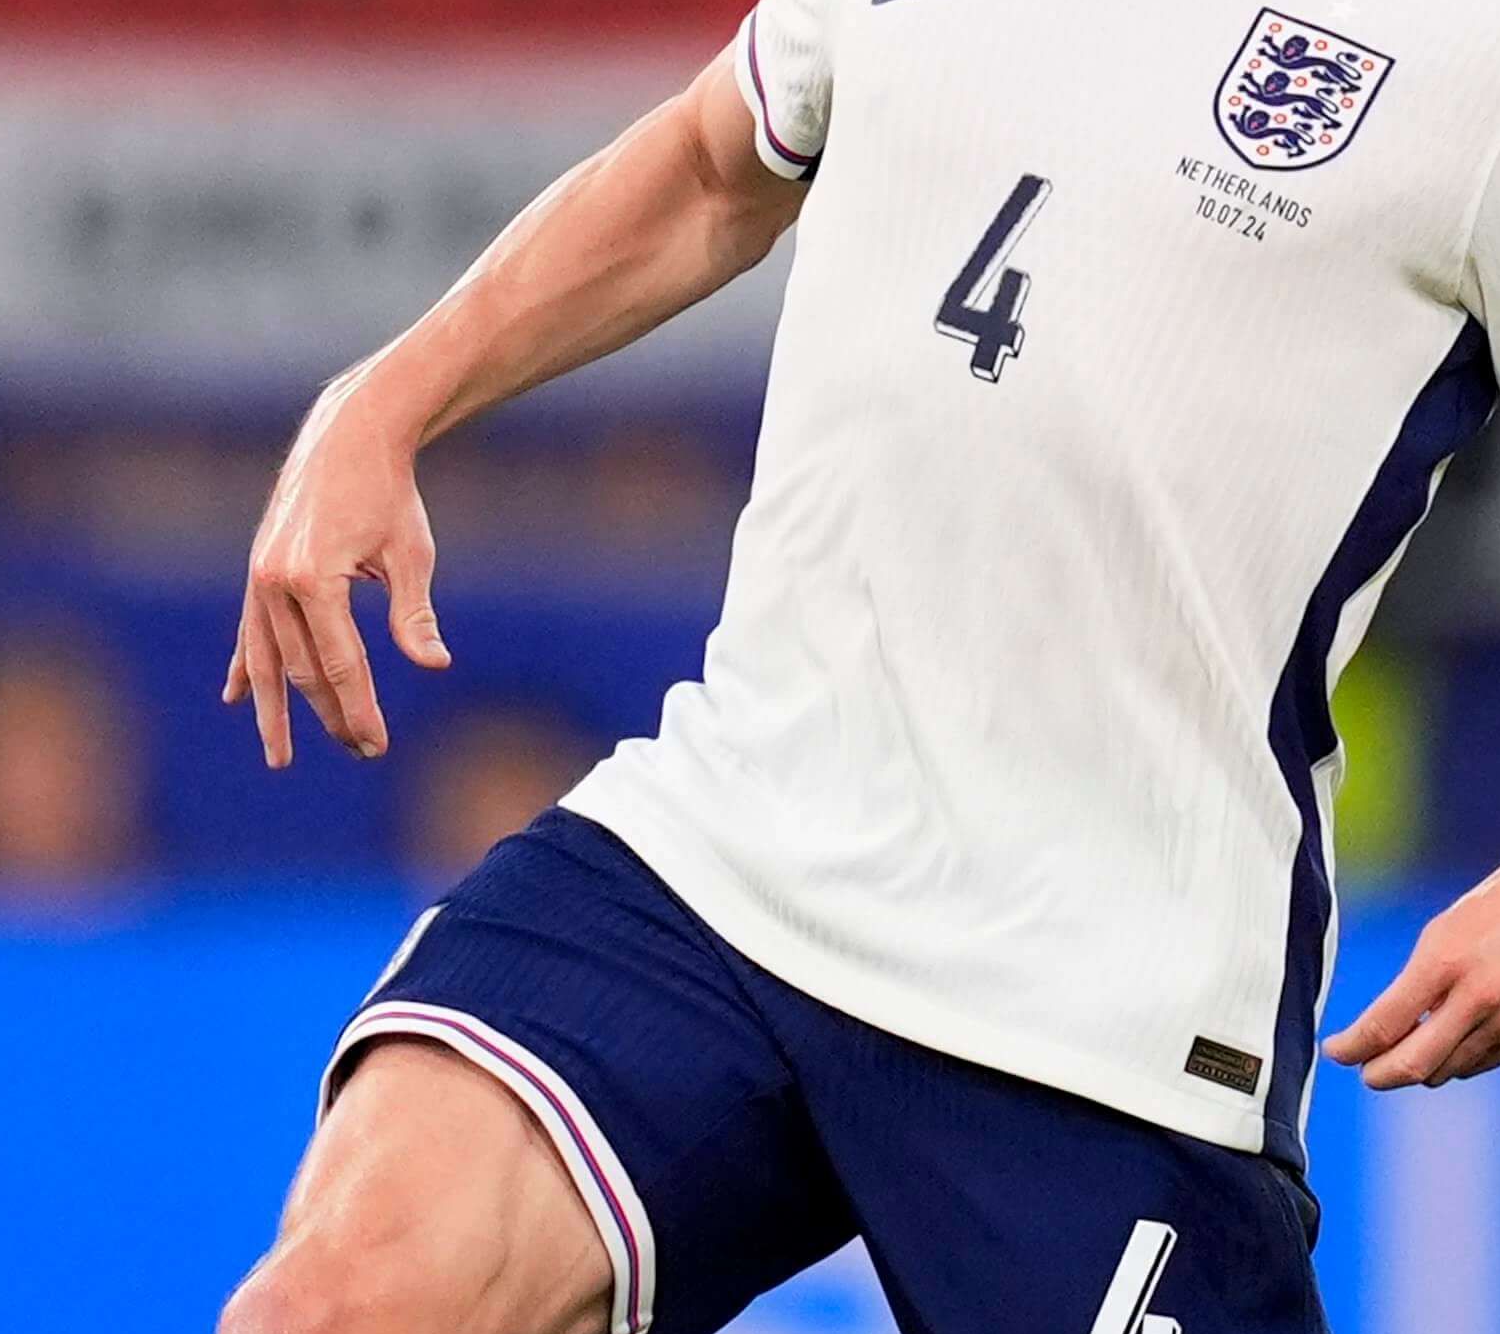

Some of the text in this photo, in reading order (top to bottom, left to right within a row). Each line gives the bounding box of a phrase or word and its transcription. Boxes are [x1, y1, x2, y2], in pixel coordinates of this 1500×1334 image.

[1175, 156, 1313, 228] NETHERLANDS
[1196, 195, 1268, 242] 10.07.24
[933, 172, 1053, 384] 4
